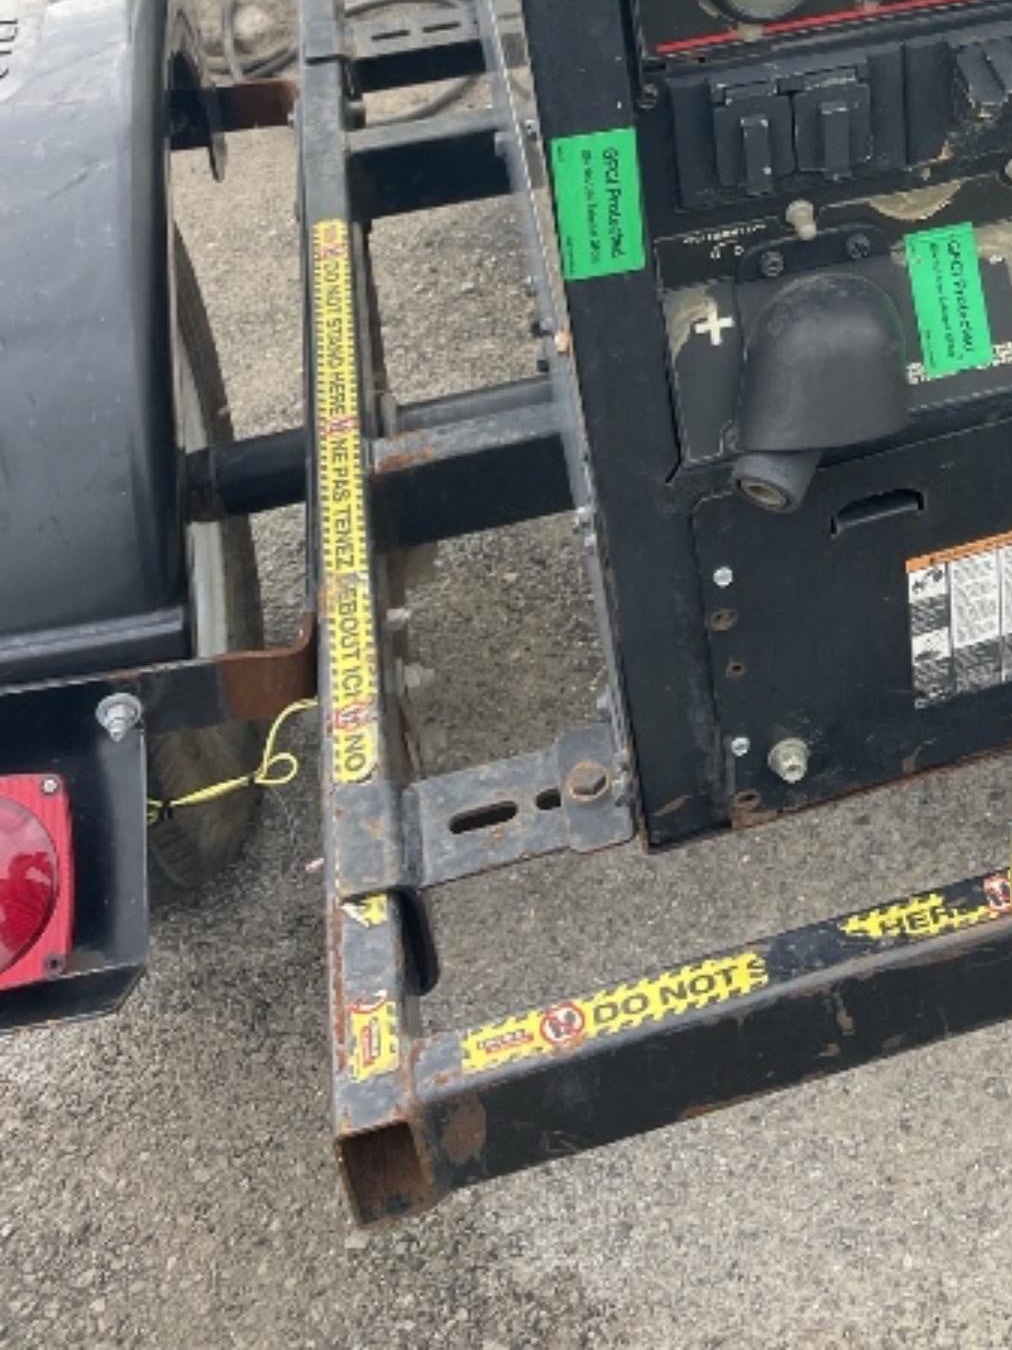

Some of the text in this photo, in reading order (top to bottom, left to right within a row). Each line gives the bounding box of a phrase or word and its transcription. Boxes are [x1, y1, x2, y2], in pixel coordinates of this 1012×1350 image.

[323, 262, 340, 283] DO
[325, 287, 342, 314] NOT
[326, 319, 344, 369] STAND
[329, 372, 346, 417] HERE
[331, 438, 349, 462] NE
[332, 467, 351, 502] PAS
[334, 507, 355, 570] TENEZ
[337, 578, 360, 660] EBOUT
[345, 734, 367, 772] NO
[593, 993, 650, 1024] DO
[659, 965, 738, 1005] NOT
